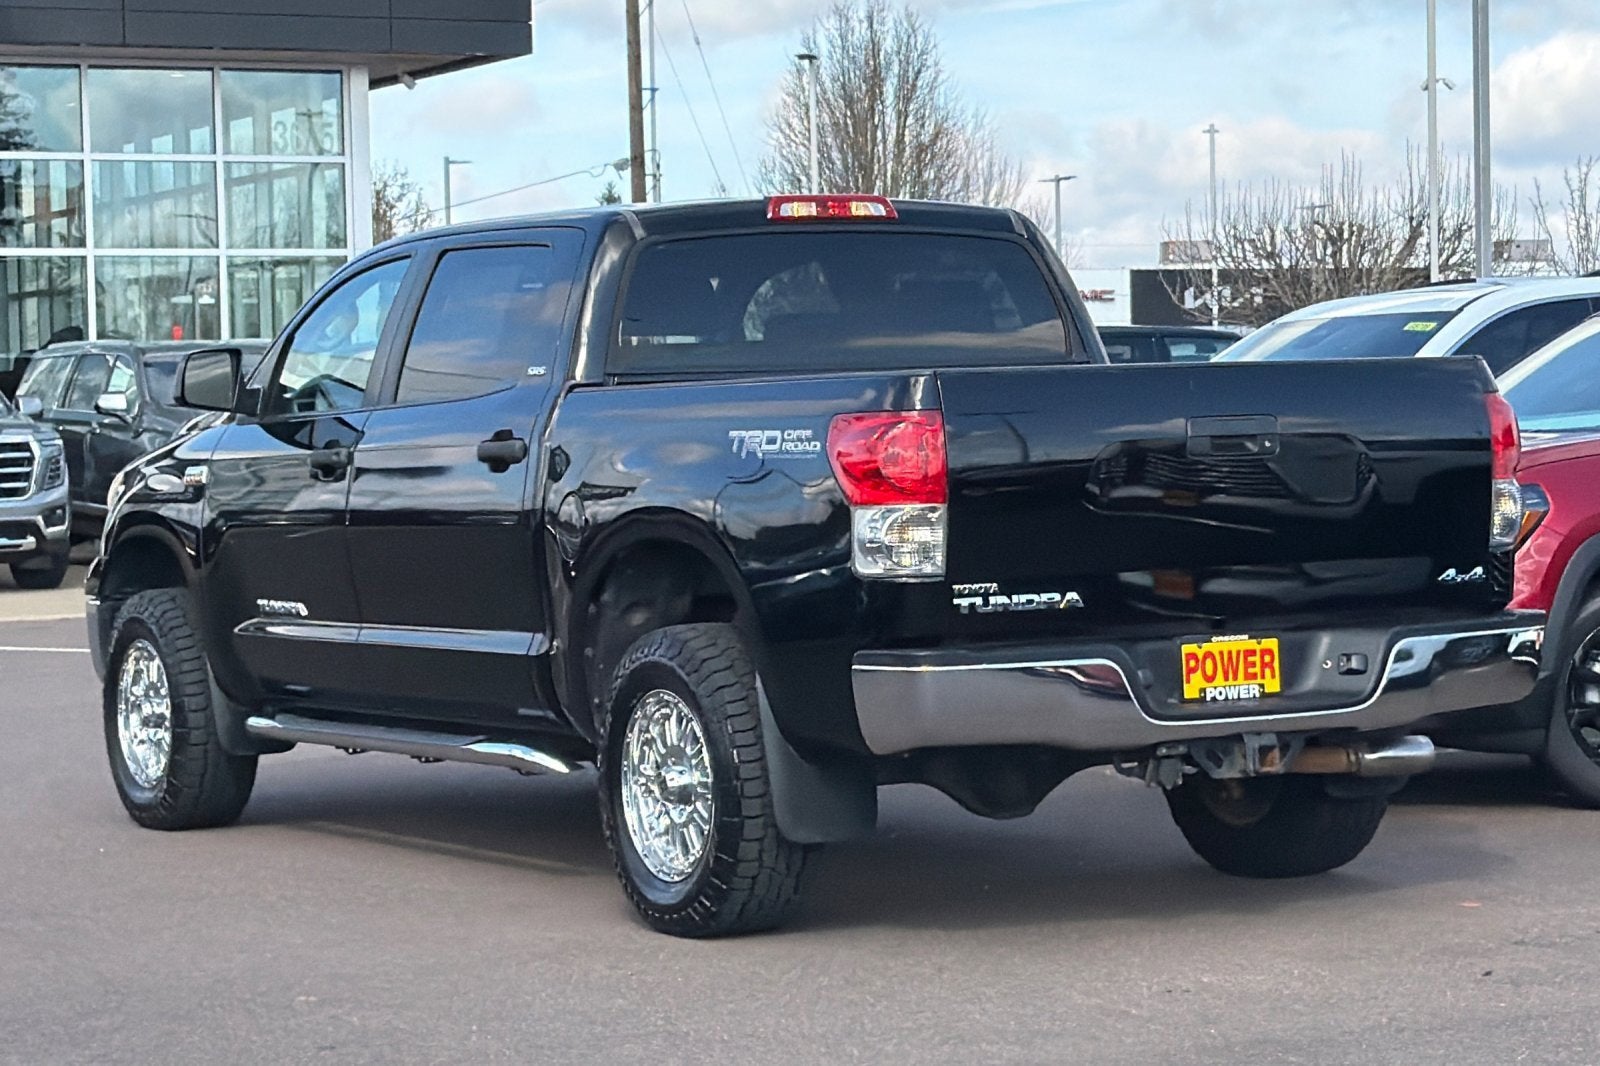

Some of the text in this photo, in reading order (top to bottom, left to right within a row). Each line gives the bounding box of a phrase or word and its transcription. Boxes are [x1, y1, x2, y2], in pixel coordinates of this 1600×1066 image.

[1079, 289, 1115, 301] MC
[728, 430, 782, 459] TRD
[782, 441, 821, 452] ROAD
[952, 582, 999, 595] TOYOTA
[952, 591, 1085, 615] TUNDRA
[1184, 647, 1276, 685] POWER
[1205, 683, 1260, 702] POWER
